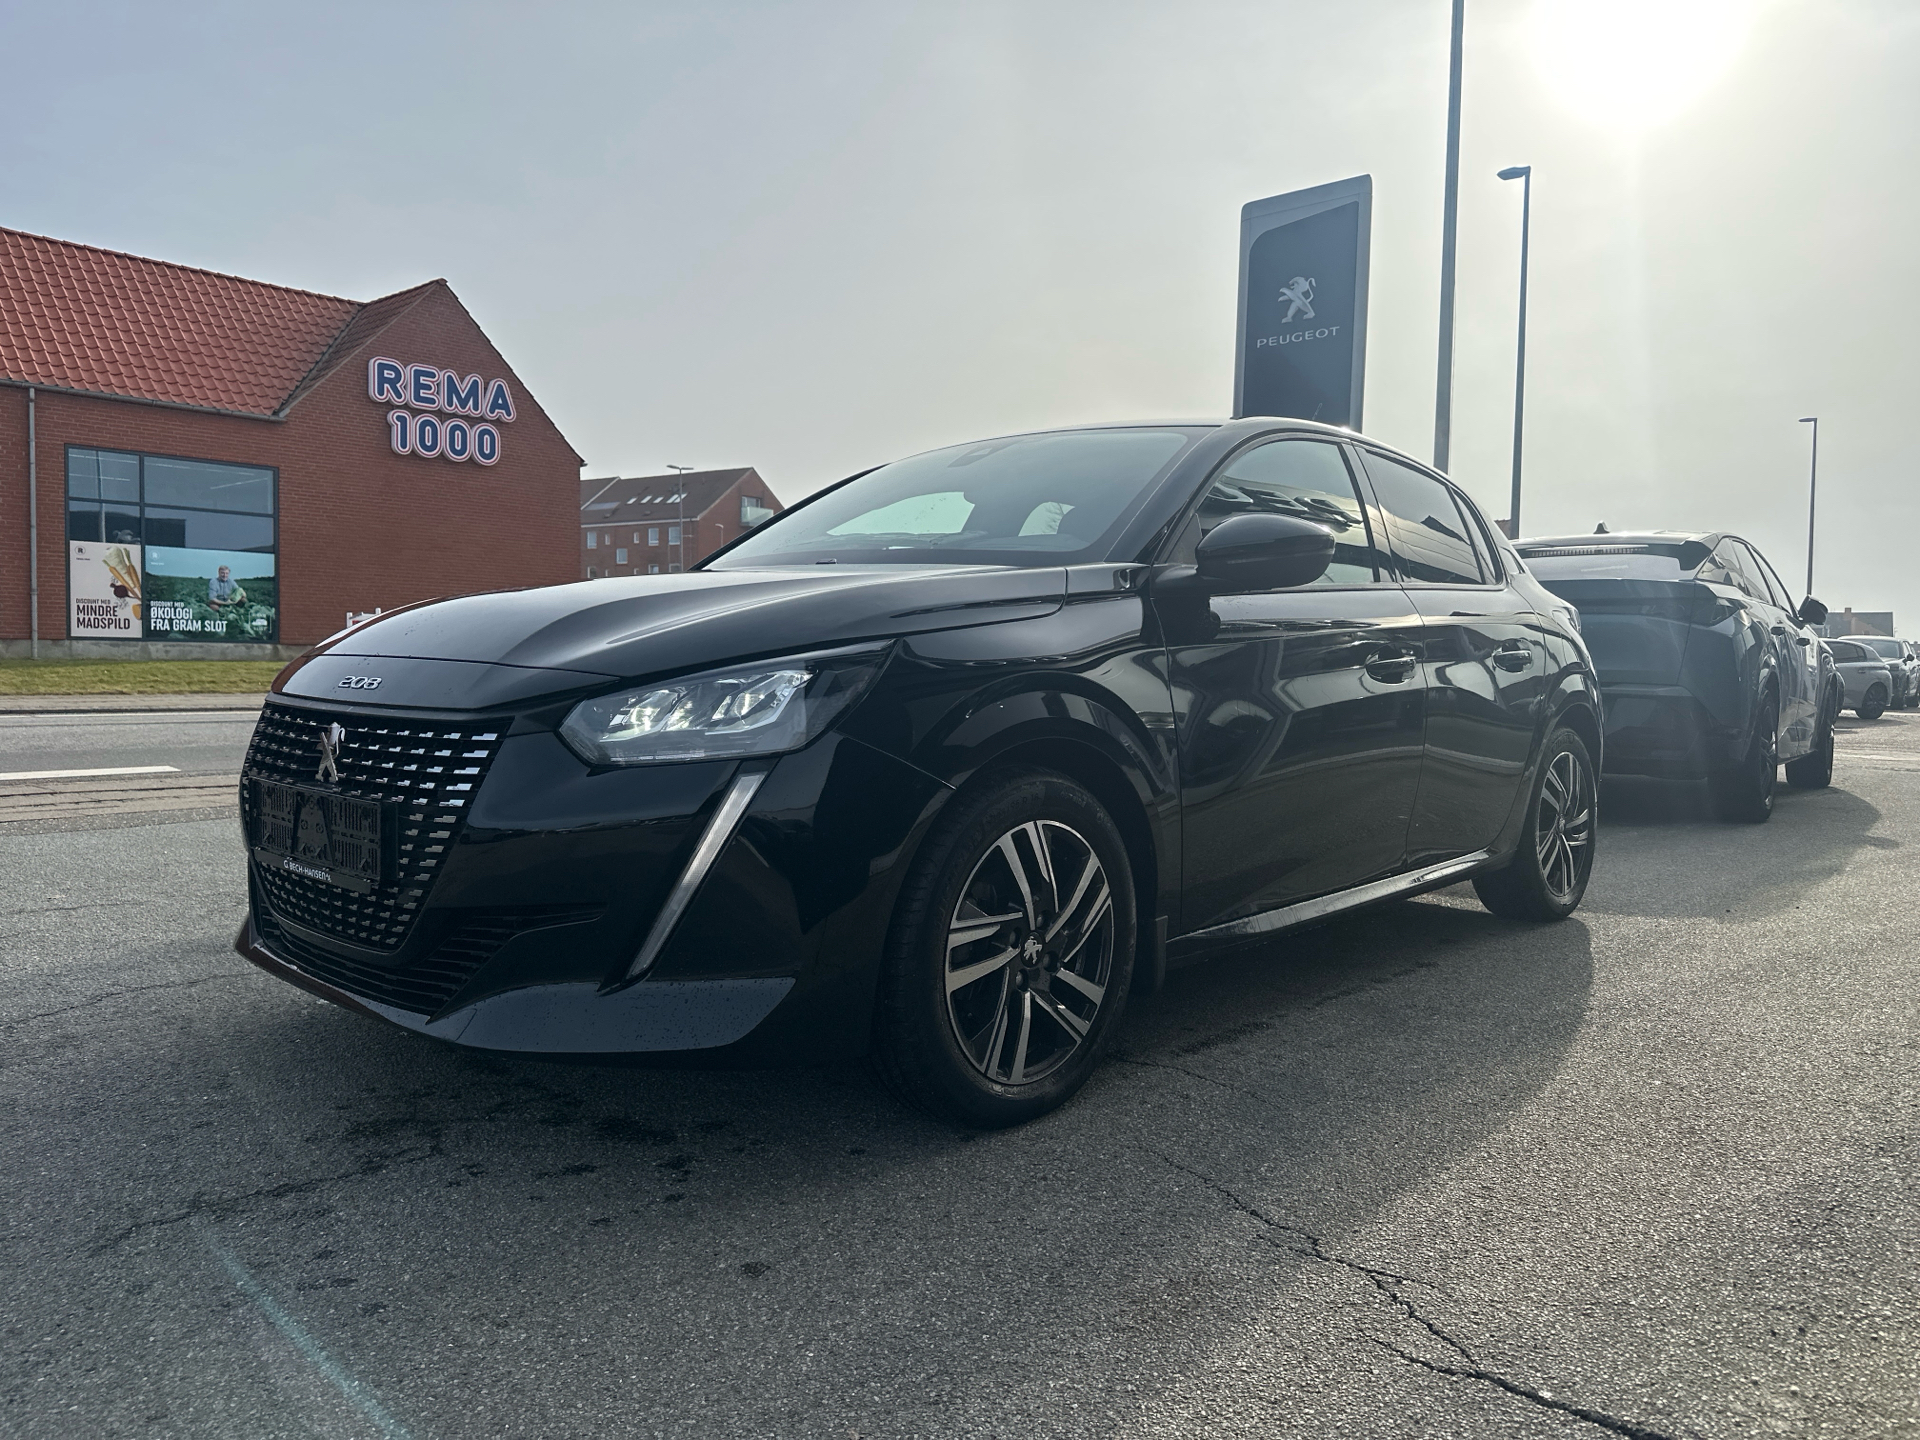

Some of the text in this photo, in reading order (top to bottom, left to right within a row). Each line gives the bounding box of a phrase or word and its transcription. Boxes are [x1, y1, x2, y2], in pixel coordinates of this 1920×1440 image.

[1256, 326, 1340, 348] PEUGEOT
[369, 357, 516, 422] REMA
[388, 410, 500, 466] 1000
[76, 604, 118, 617] MINDRE
[150, 607, 193, 619] ØKOLOGI
[76, 616, 131, 630] MADSPILD
[150, 619, 228, 632] FRA GRAM SLOT
[338, 675, 382, 690] 208
